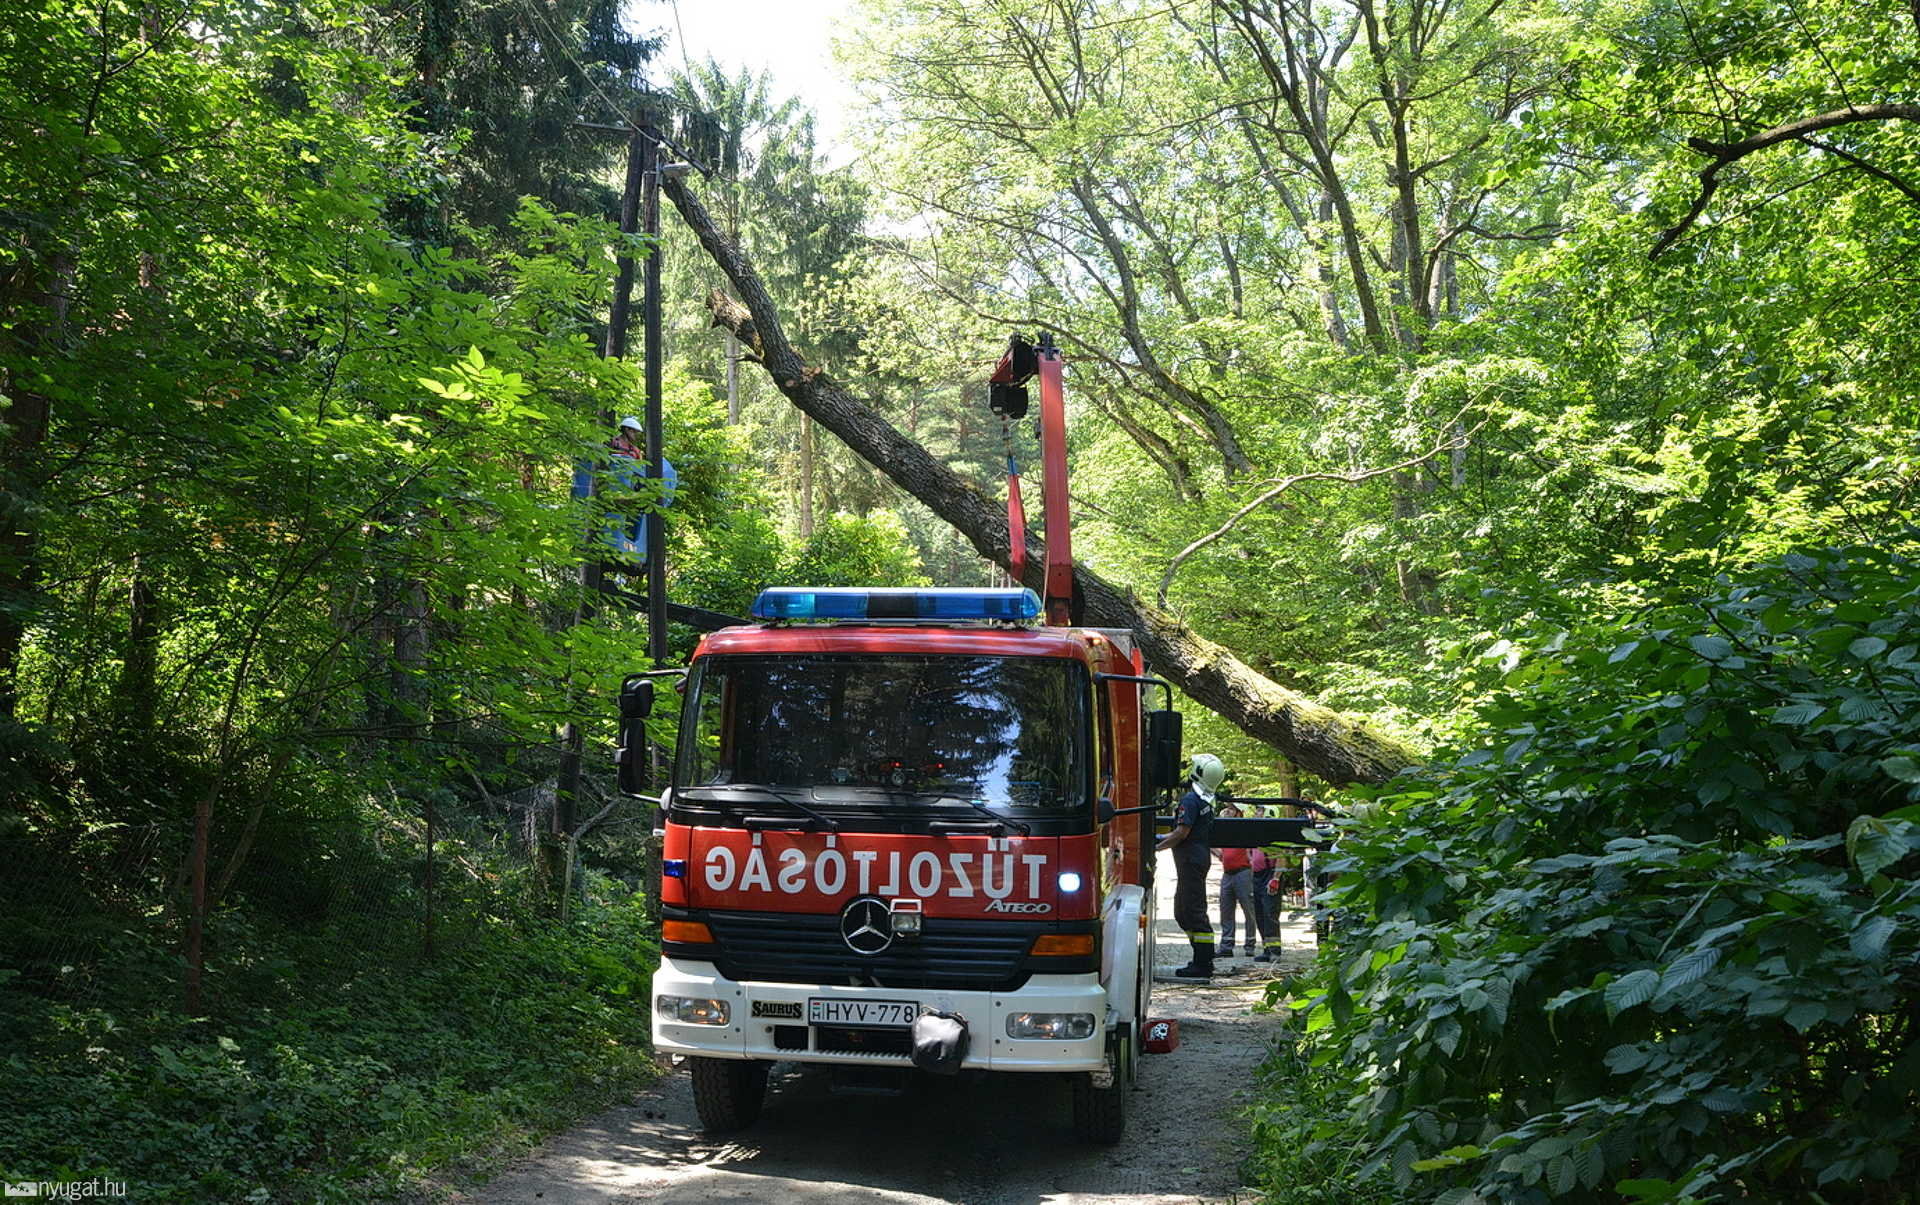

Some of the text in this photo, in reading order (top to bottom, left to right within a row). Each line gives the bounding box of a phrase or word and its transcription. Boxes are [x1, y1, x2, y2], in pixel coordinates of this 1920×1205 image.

[984, 899, 1052, 913] ATEGO
[752, 1001, 802, 1018] SAURUS
[813, 1003, 914, 1023] H HYV-778
